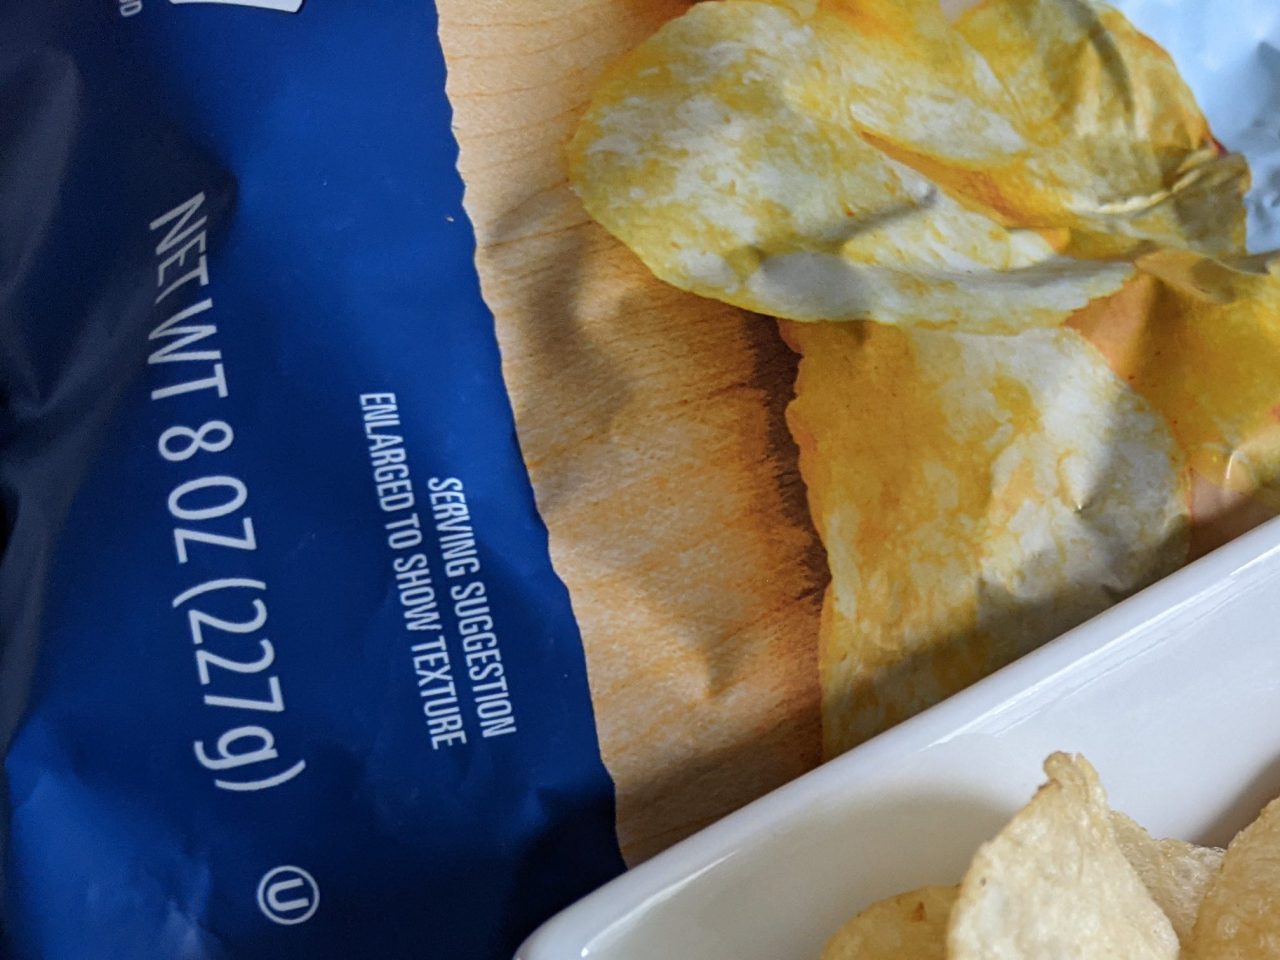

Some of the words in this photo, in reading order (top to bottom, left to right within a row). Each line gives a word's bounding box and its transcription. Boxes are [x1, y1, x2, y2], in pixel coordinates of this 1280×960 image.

[148, 191, 209, 305] NET
[147, 297, 229, 401] WT
[158, 420, 235, 462] 8
[359, 392, 416, 512] ENLARGED
[168, 475, 257, 564] OZ
[384, 513, 423, 550] TO
[427, 477, 481, 578] SERVING
[393, 553, 443, 631] SHOW
[172, 577, 306, 791] (227g)
[411, 635, 468, 750] TEXTURE
[451, 581, 517, 738] SUGGESTION
